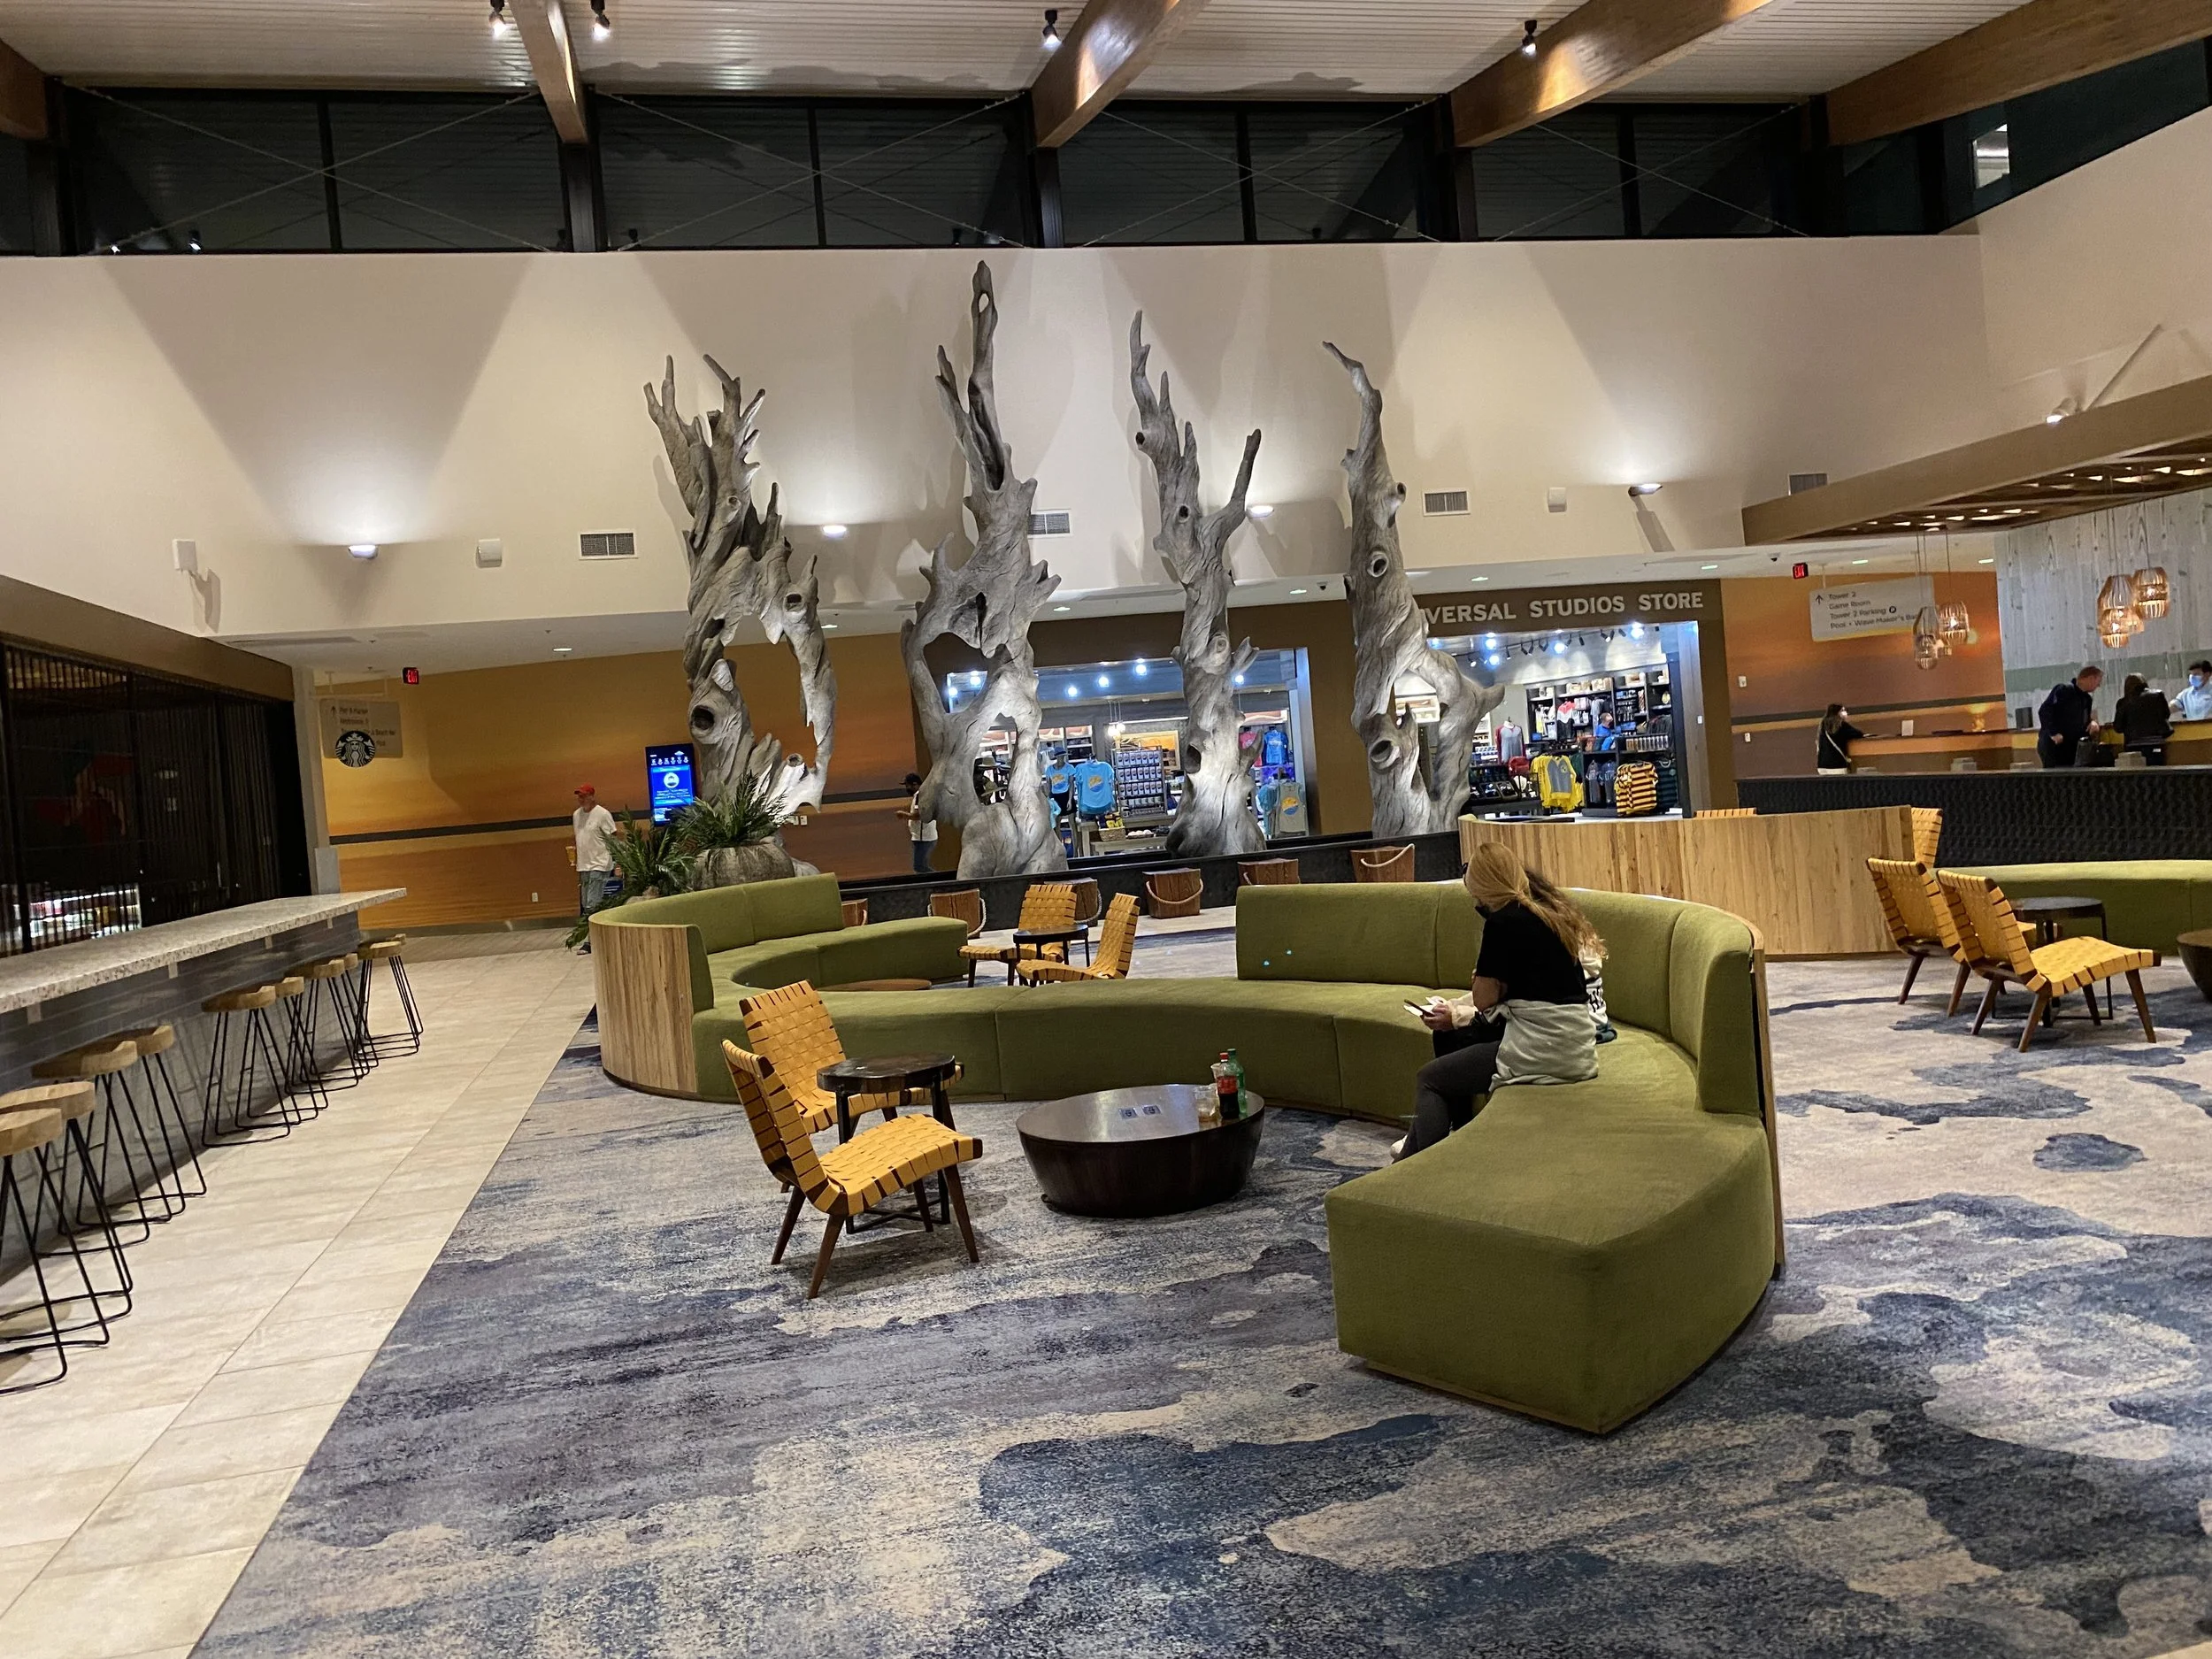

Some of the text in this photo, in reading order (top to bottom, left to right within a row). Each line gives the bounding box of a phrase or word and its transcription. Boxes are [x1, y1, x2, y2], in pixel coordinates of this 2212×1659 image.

[1528, 595, 1625, 618] STUDIOS
[1638, 592, 1704, 612] STORE
[1859, 608, 1887, 617] Parking
